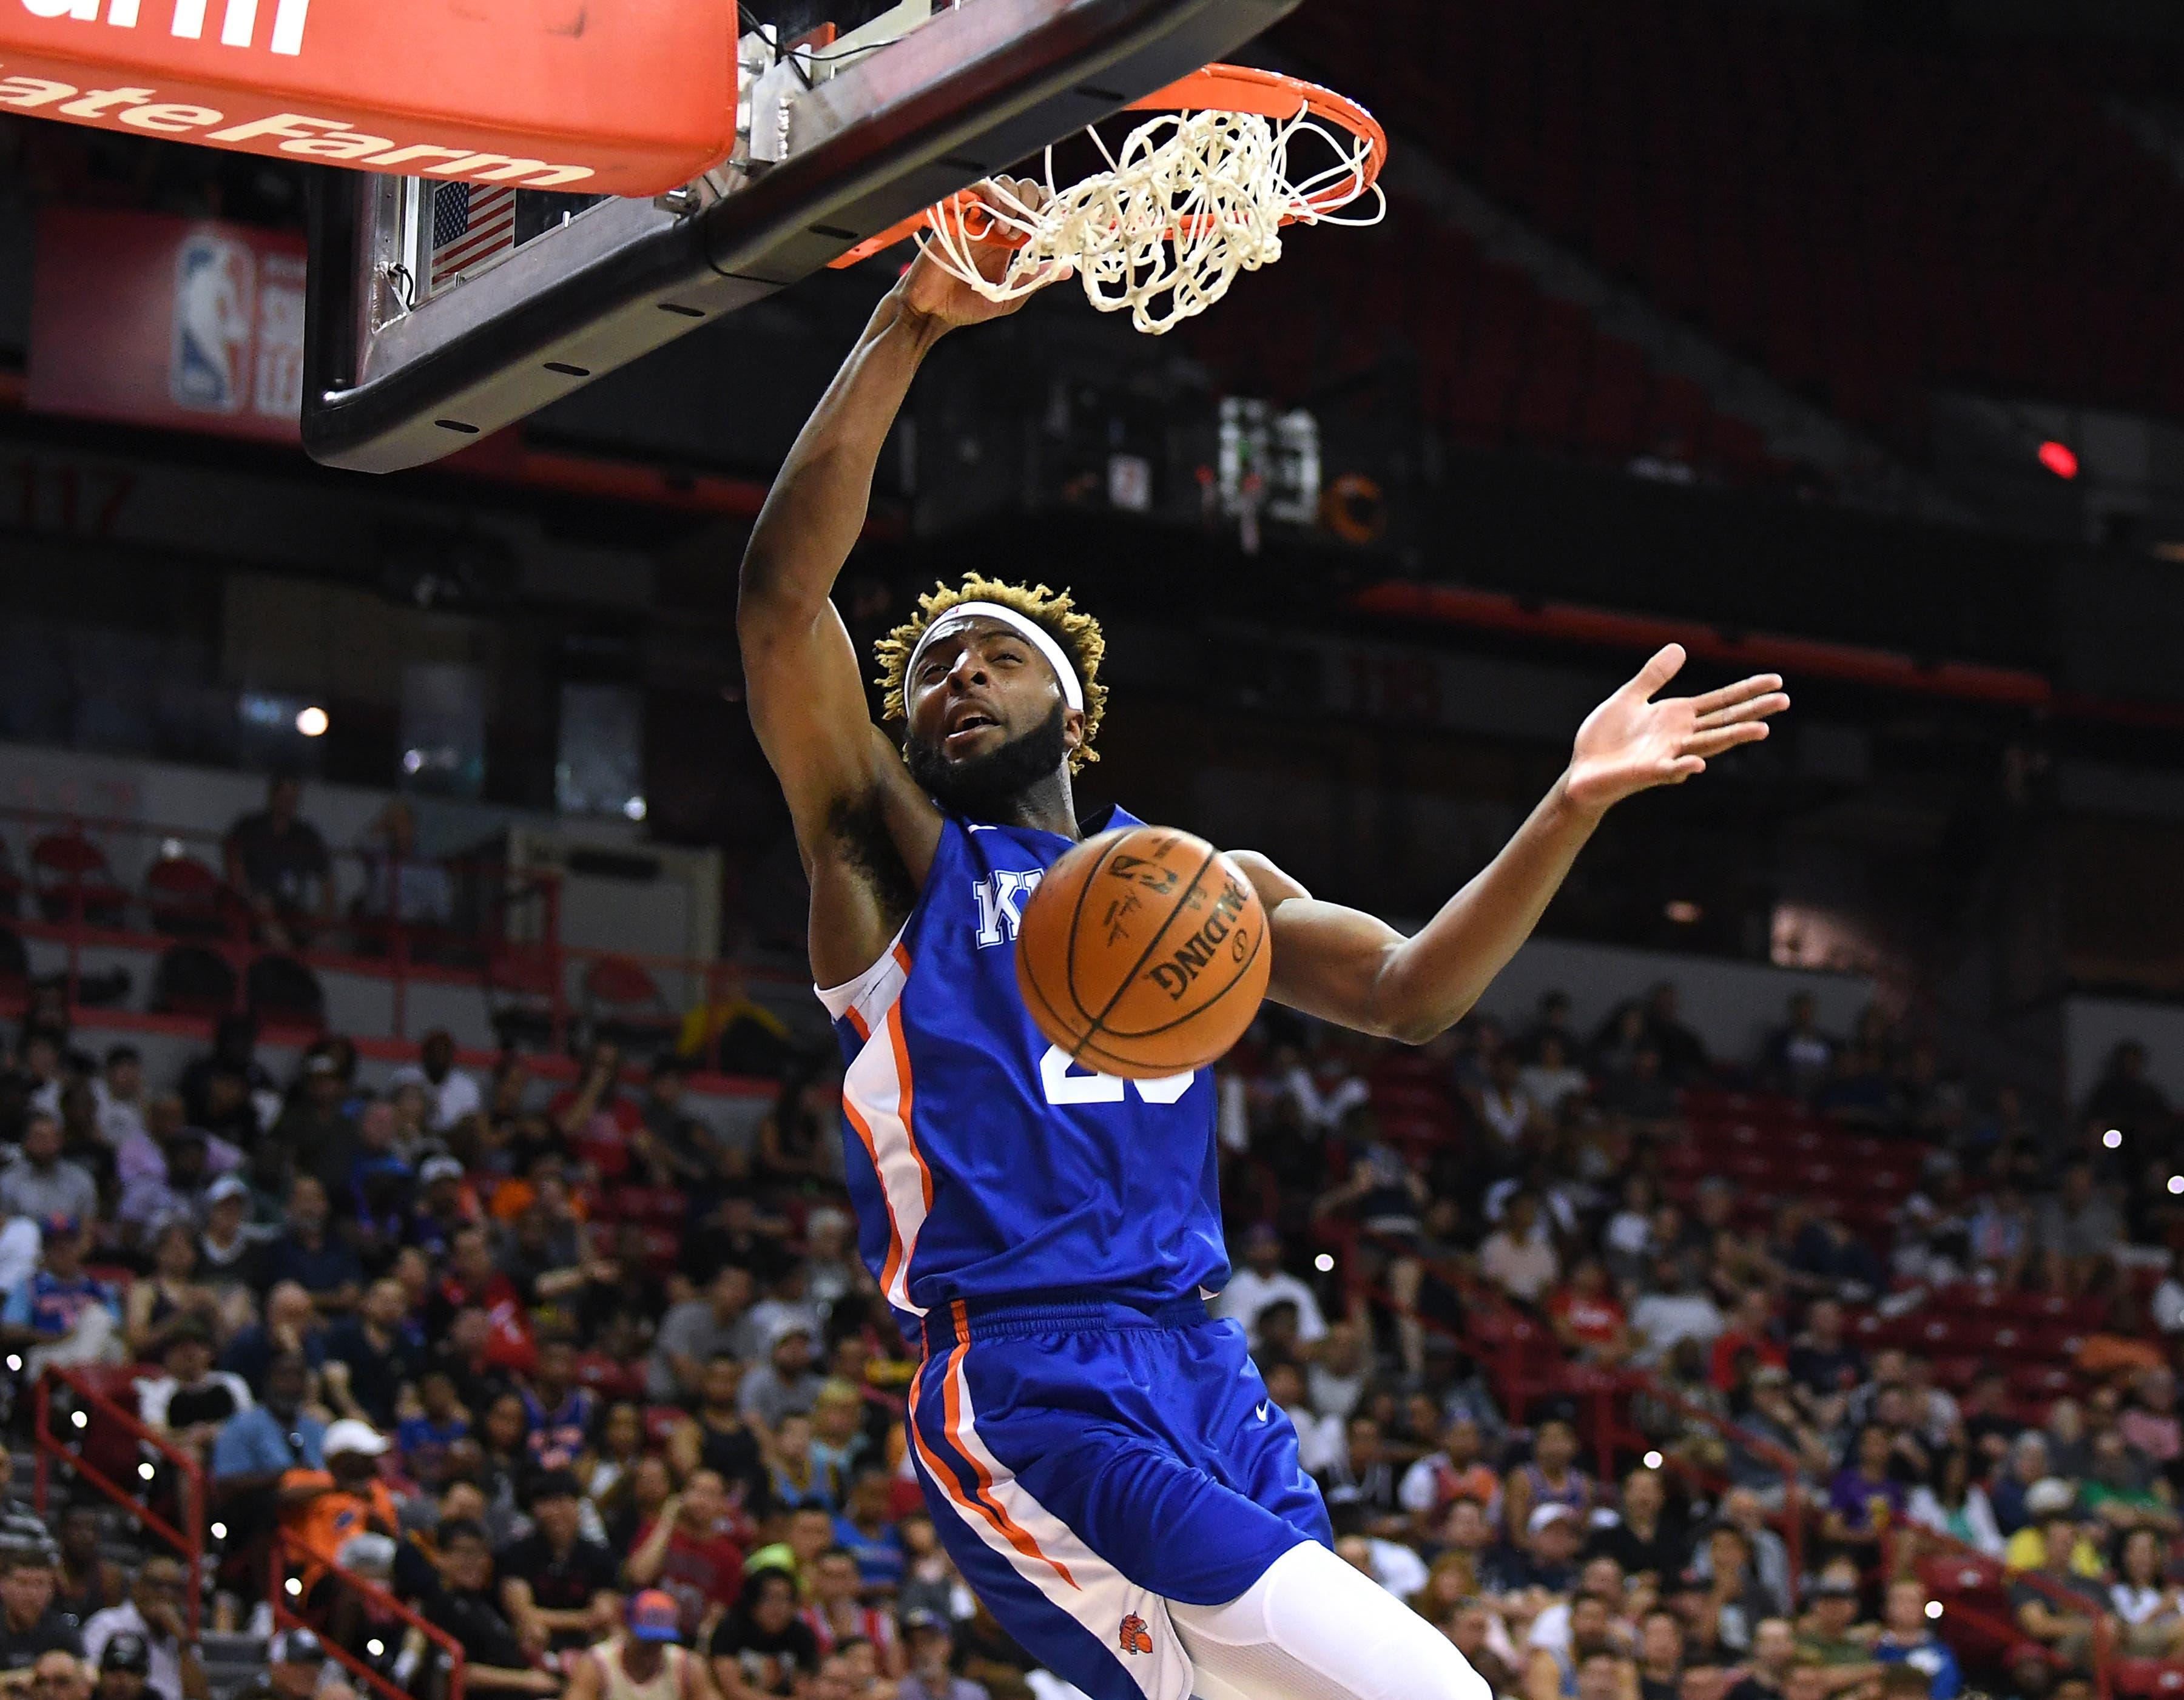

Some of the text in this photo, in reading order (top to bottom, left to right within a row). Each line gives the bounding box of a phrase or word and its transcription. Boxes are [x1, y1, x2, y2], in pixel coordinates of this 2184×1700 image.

[0, 64, 595, 186] ate Farm
[1149, 870, 1250, 1001] PALDING
